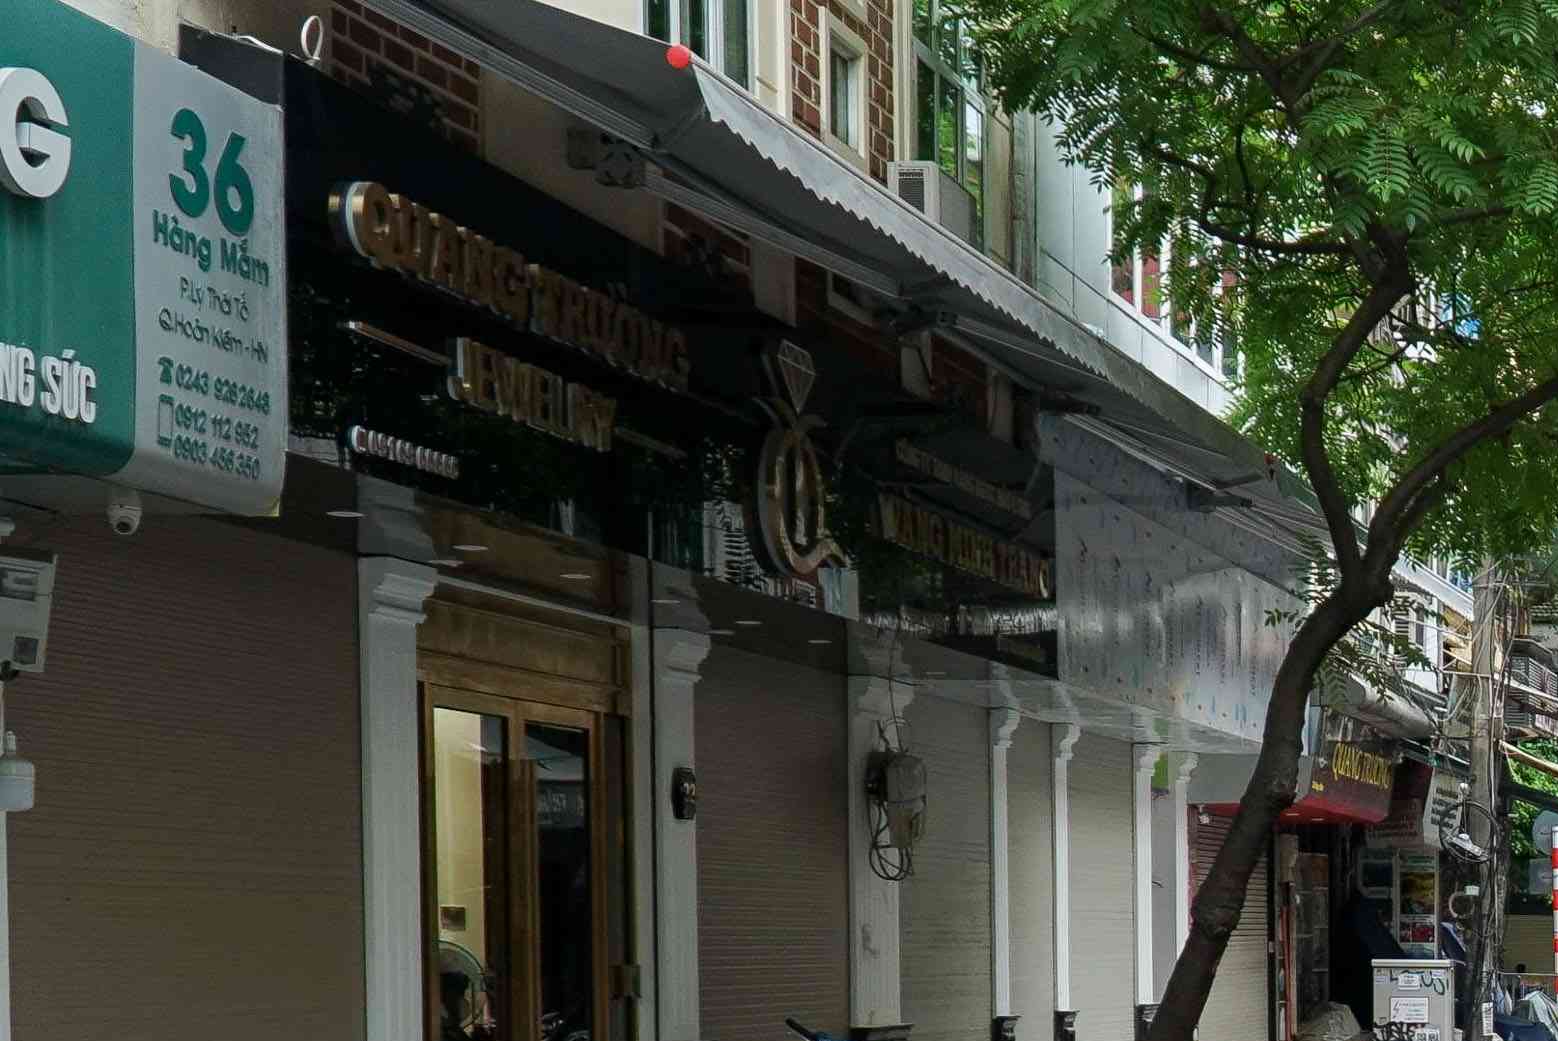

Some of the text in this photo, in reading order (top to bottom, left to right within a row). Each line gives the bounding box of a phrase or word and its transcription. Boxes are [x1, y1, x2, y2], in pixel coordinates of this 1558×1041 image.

[169, 108, 254, 237] 36
[153, 209, 268, 286] Hàng Mắm
[41, 349, 97, 424] SỨC
